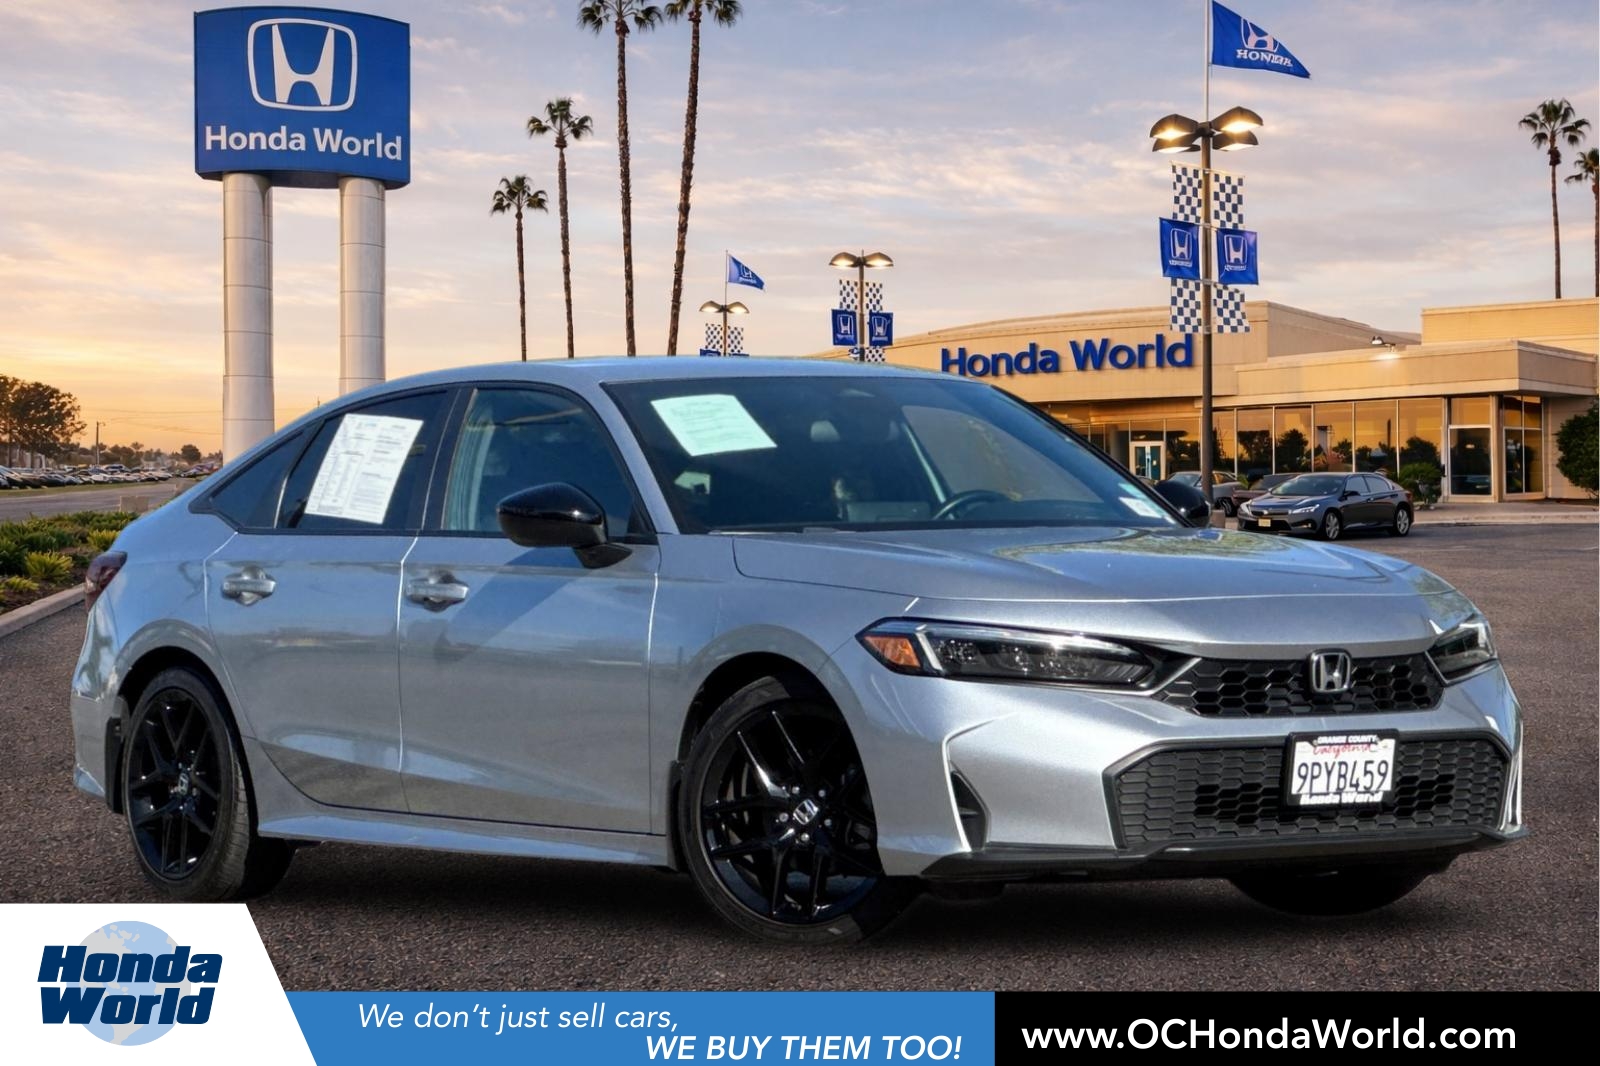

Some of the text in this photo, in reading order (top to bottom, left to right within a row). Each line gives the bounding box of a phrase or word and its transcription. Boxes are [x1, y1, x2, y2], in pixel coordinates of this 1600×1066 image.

[205, 125, 402, 161] Honda World
[941, 333, 1194, 377] Honda World
[1297, 760, 1389, 793] 9PYB459
